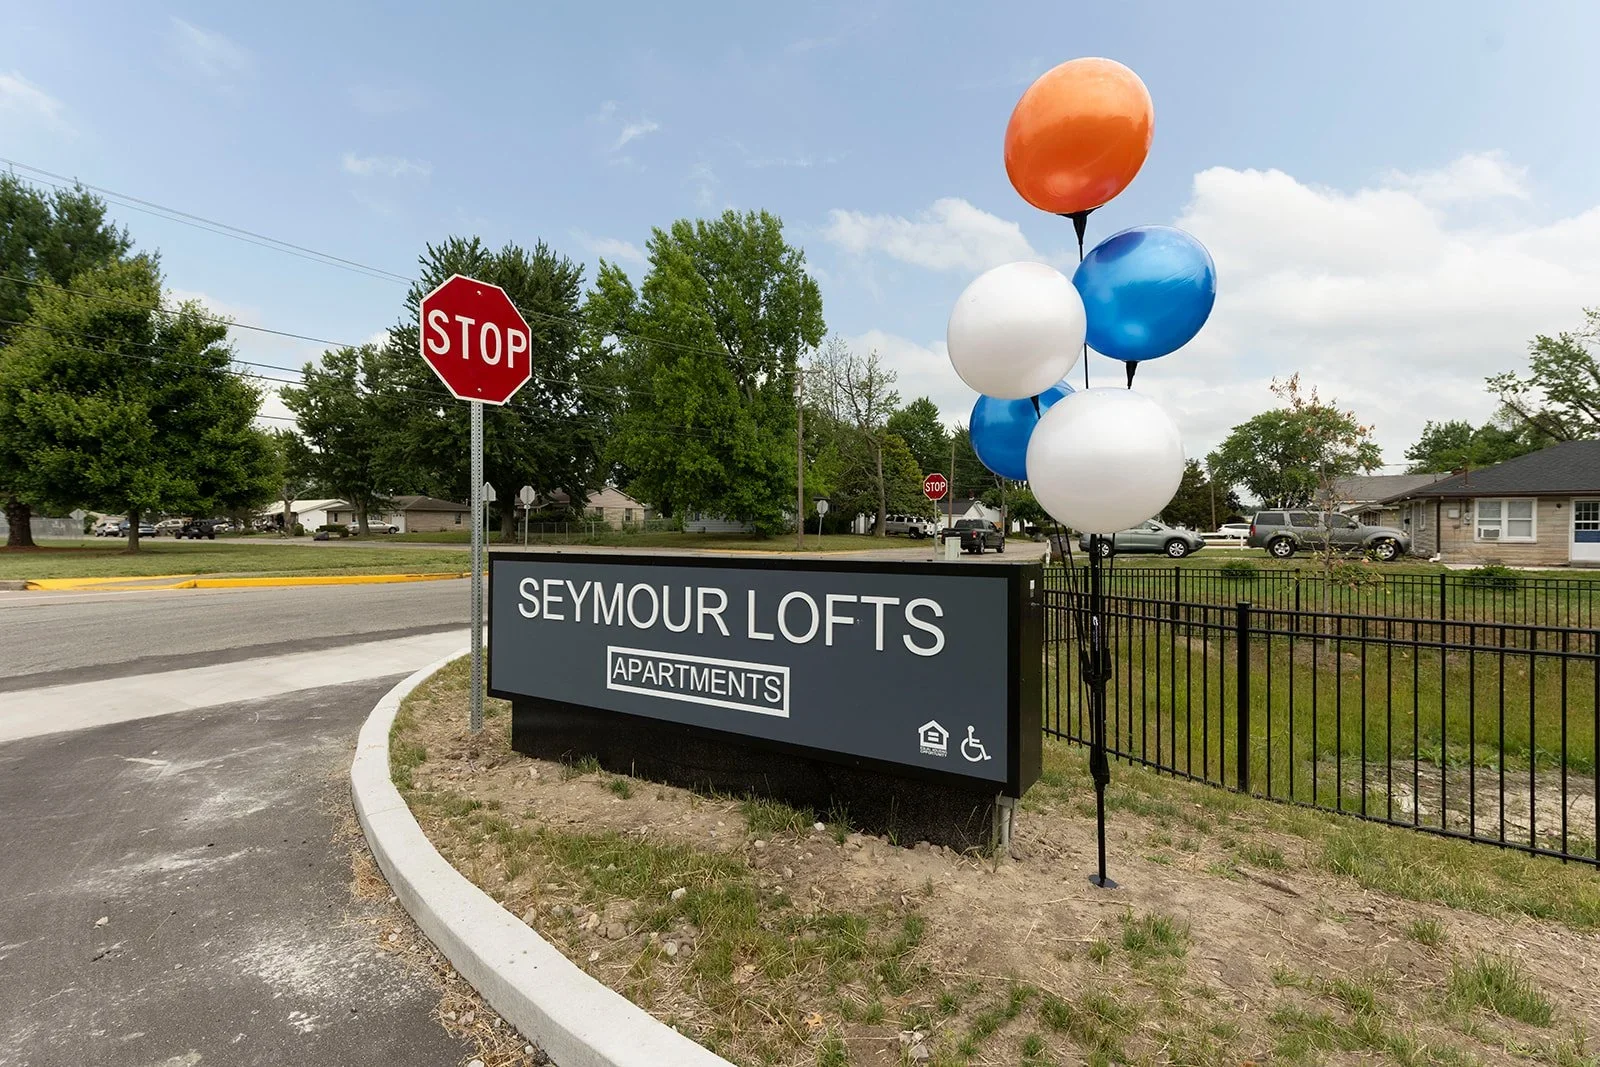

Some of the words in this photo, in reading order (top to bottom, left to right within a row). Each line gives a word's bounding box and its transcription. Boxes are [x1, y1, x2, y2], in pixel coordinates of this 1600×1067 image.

[427, 309, 527, 368] STOP
[925, 481, 946, 492] STOP
[518, 577, 730, 636] SEYMOUR
[748, 590, 945, 656] LOFTS
[612, 656, 782, 703] APARTMENTS
